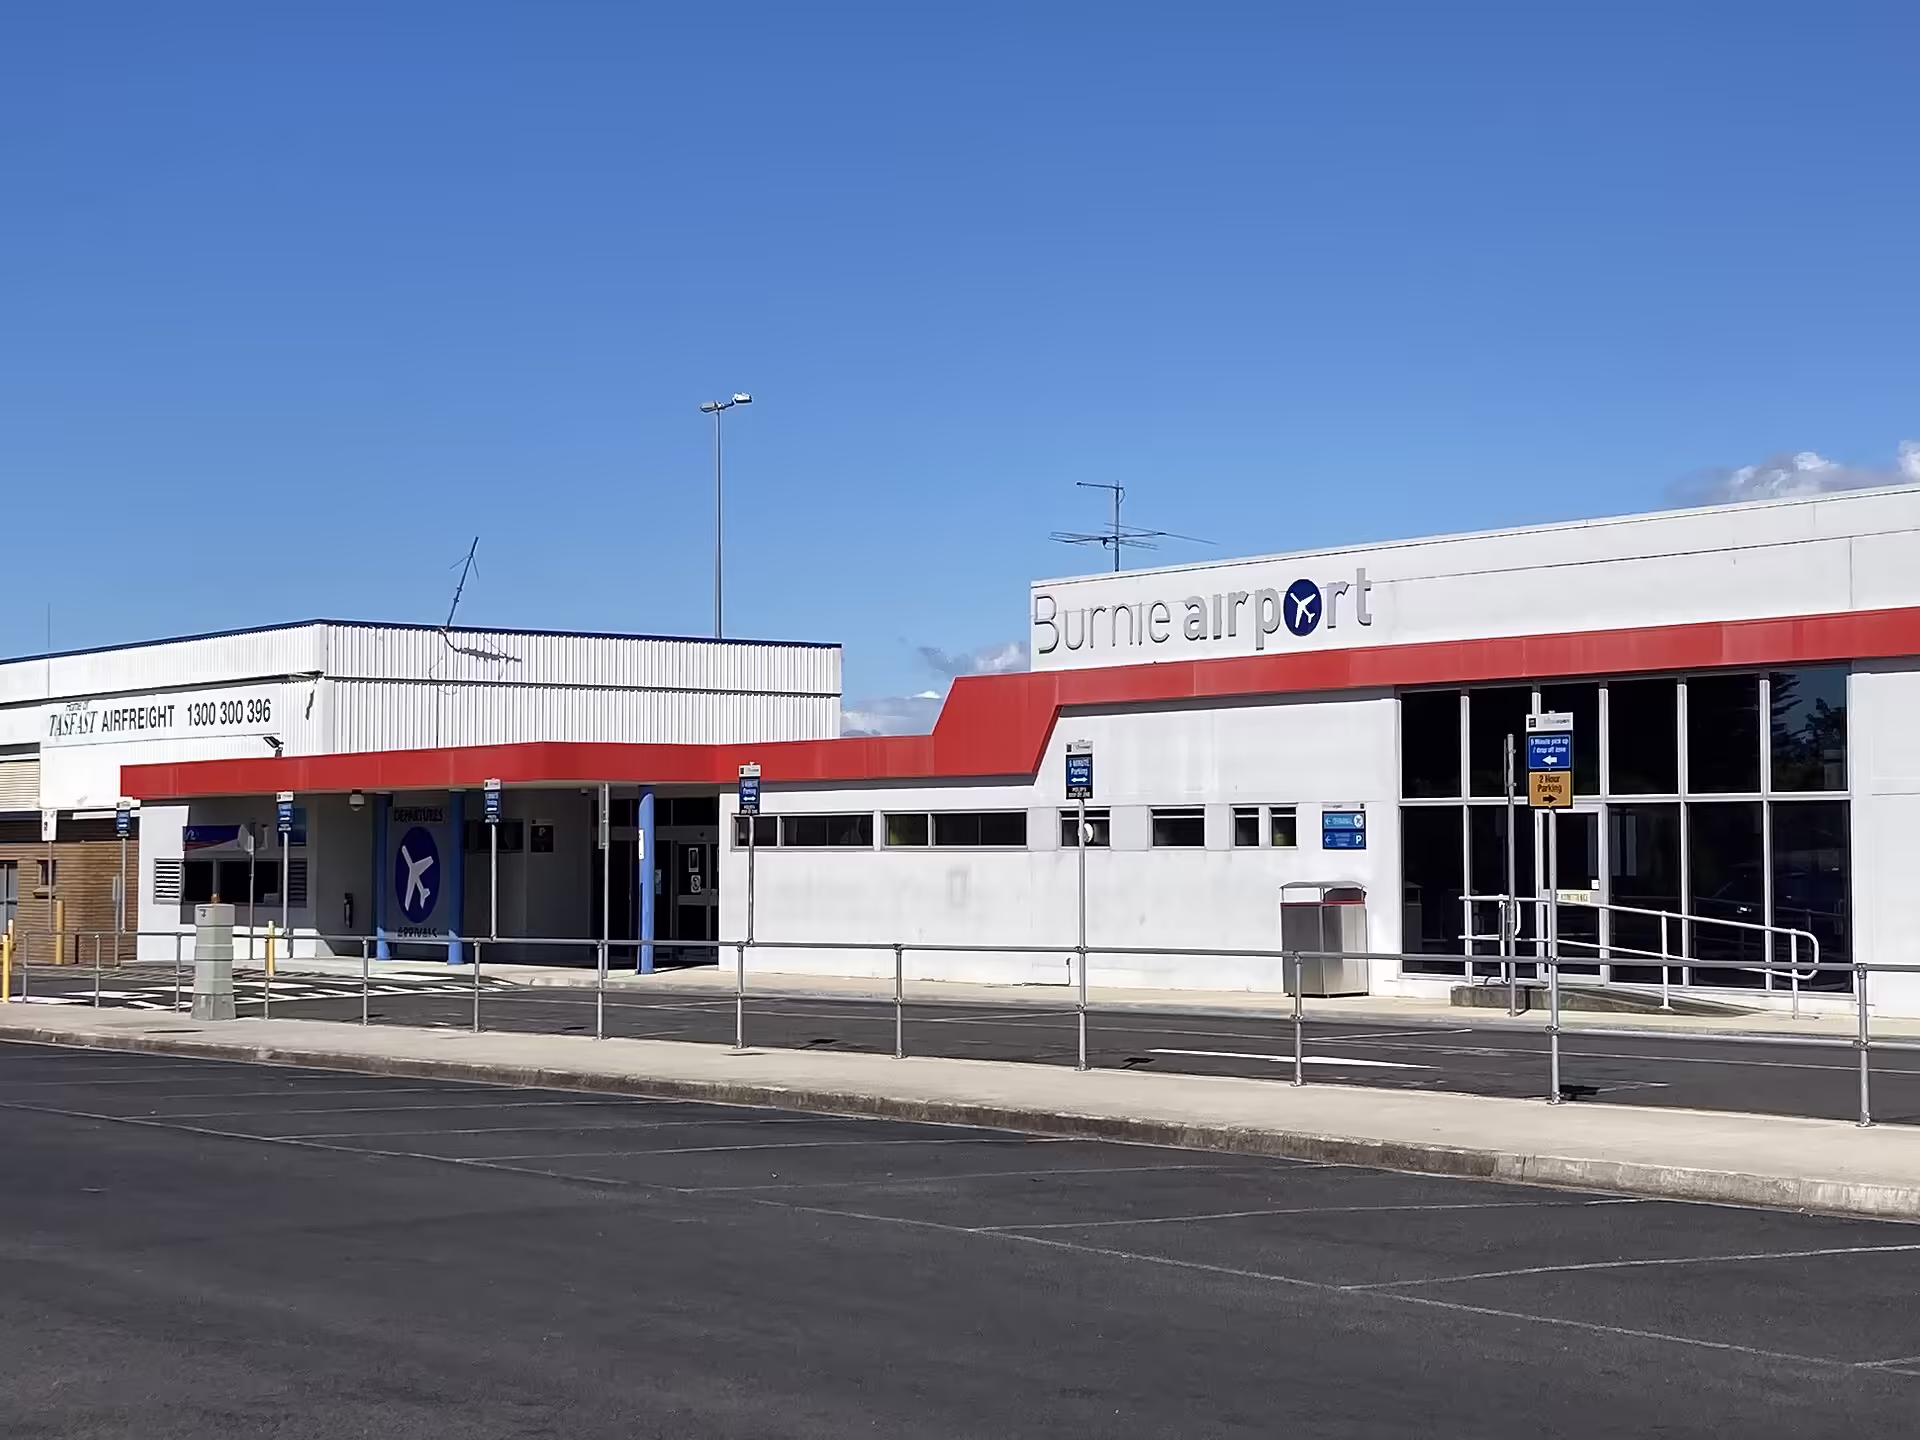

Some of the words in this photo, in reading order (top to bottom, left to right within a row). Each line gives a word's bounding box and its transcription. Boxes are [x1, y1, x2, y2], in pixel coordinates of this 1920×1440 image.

[1034, 592, 1171, 654] Burnie
[1182, 567, 1373, 650] airport
[49, 710, 98, 737] TASFAST
[101, 705, 175, 732] AIRFREIGHT
[187, 702, 216, 726] 1300
[219, 700, 243, 724] 300
[246, 698, 271, 723] 396
[1538, 775, 1544, 783] 2
[1545, 775, 1560, 783] Hour
[1537, 784, 1562, 794] Parking
[393, 807, 444, 823] DEPARTURES
[1355, 835, 1362, 845] P
